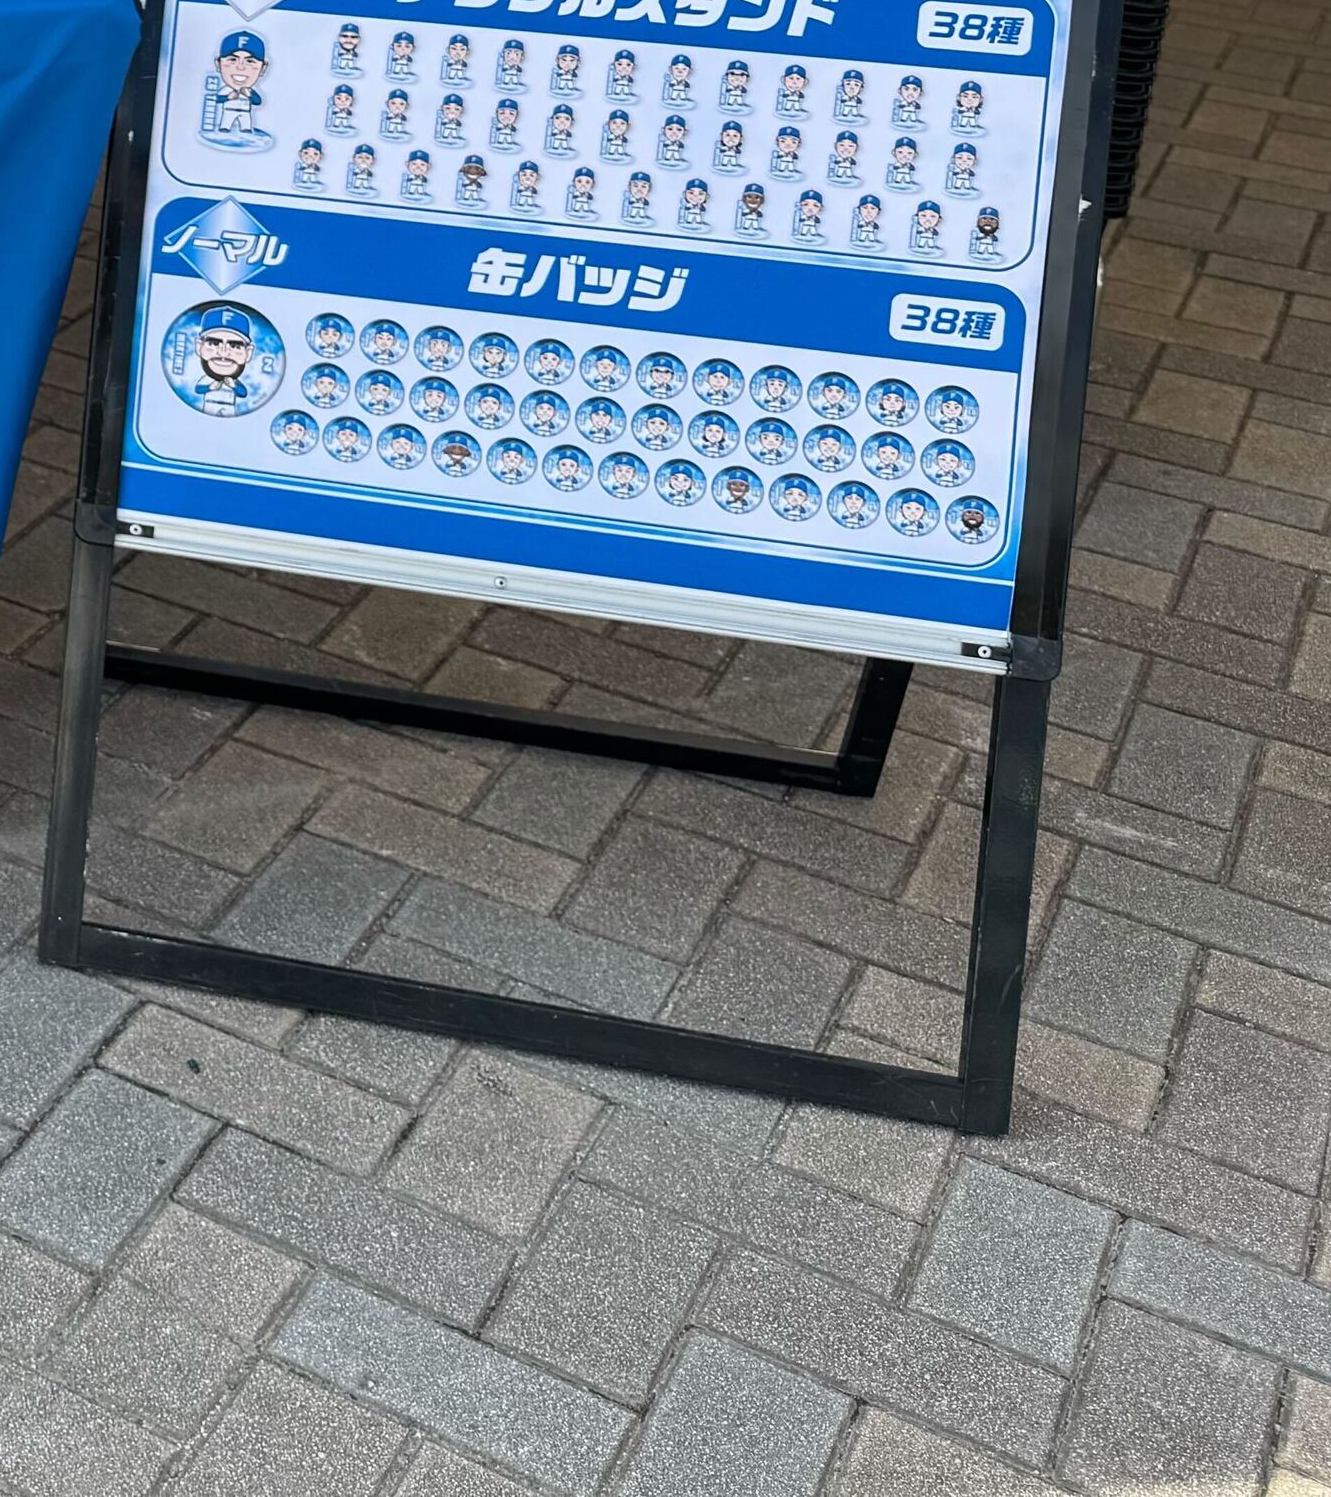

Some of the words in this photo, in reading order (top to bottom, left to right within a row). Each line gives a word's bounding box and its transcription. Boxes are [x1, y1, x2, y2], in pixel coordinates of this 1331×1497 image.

[926, 8, 1025, 47] 38種
[162, 224, 289, 268] ノーマル
[467, 246, 687, 311] 缶バッジ
[222, 311, 234, 326] F
[898, 304, 996, 343] 38種
